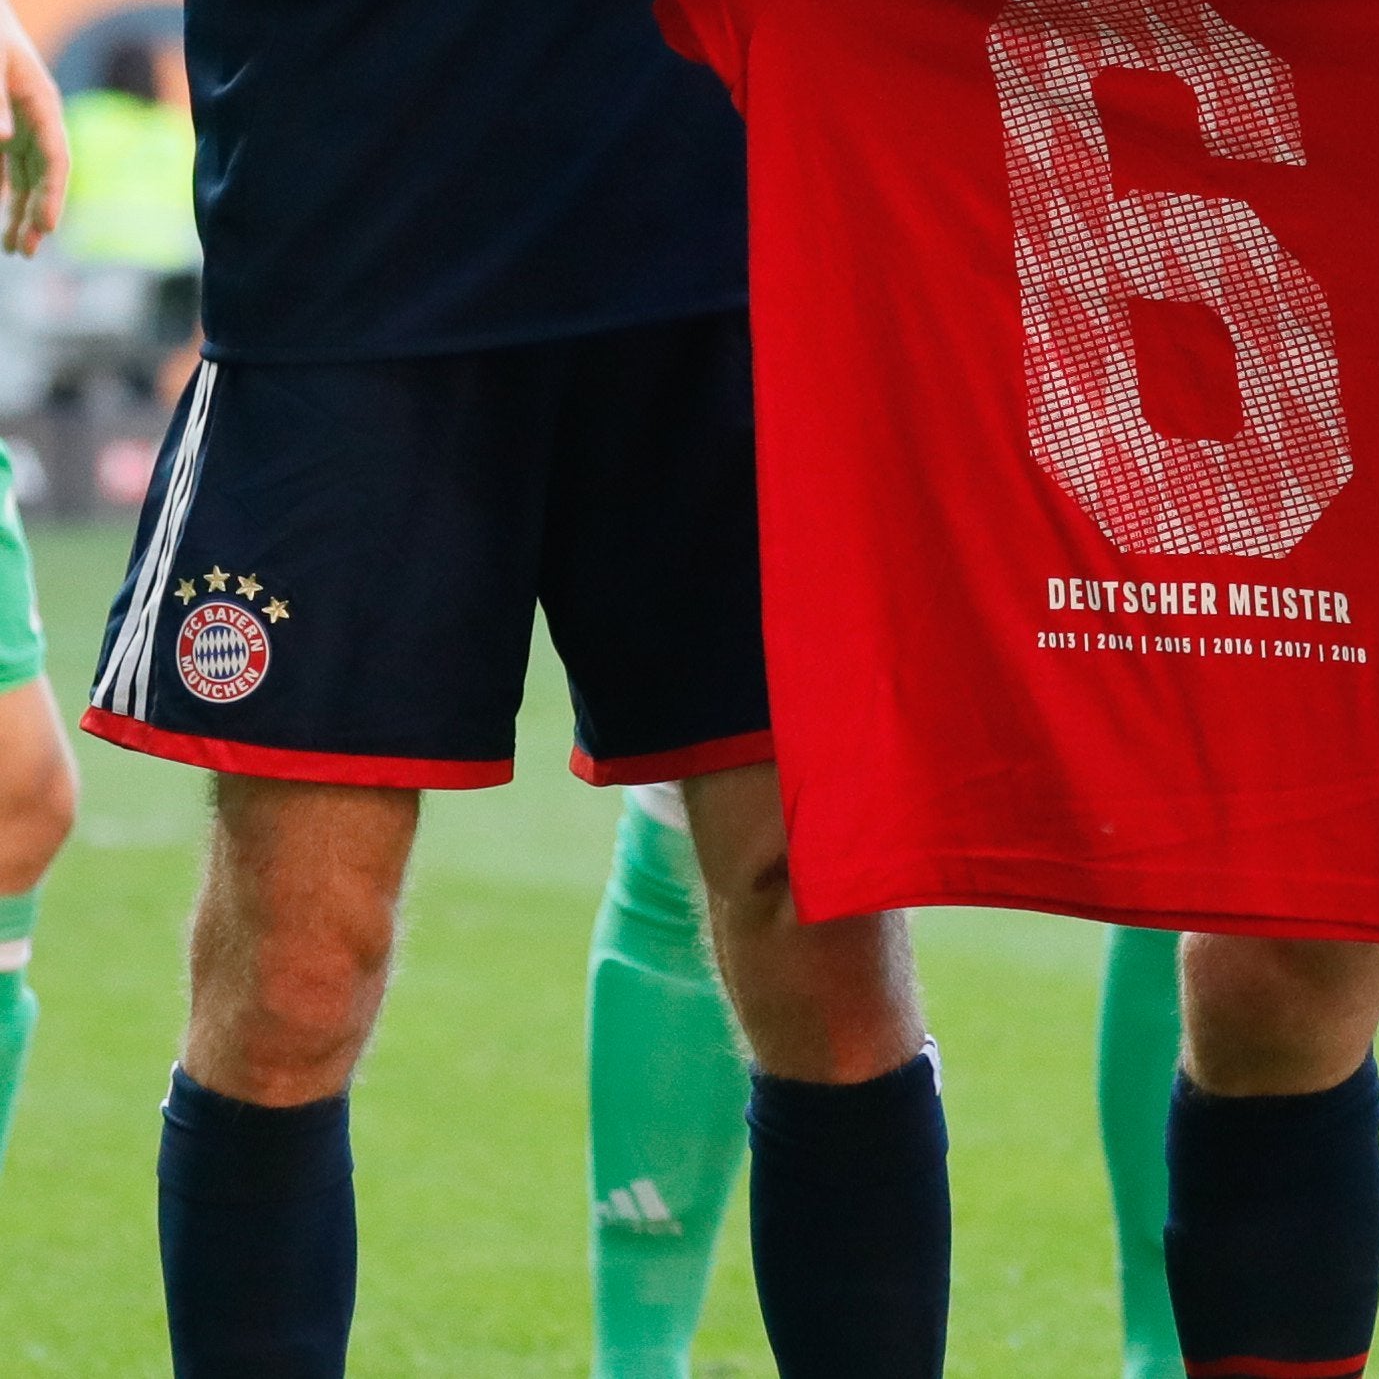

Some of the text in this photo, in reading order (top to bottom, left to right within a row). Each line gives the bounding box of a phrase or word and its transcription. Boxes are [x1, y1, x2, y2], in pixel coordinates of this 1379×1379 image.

[1047, 577, 1352, 624] DEUTSCHER MEISTER
[184, 607, 264, 652] FC BAYERN
[1037, 631, 1367, 664] 2013 2014 2015 2016 2017 2018
[181, 655, 260, 699] MÜNCHEN
